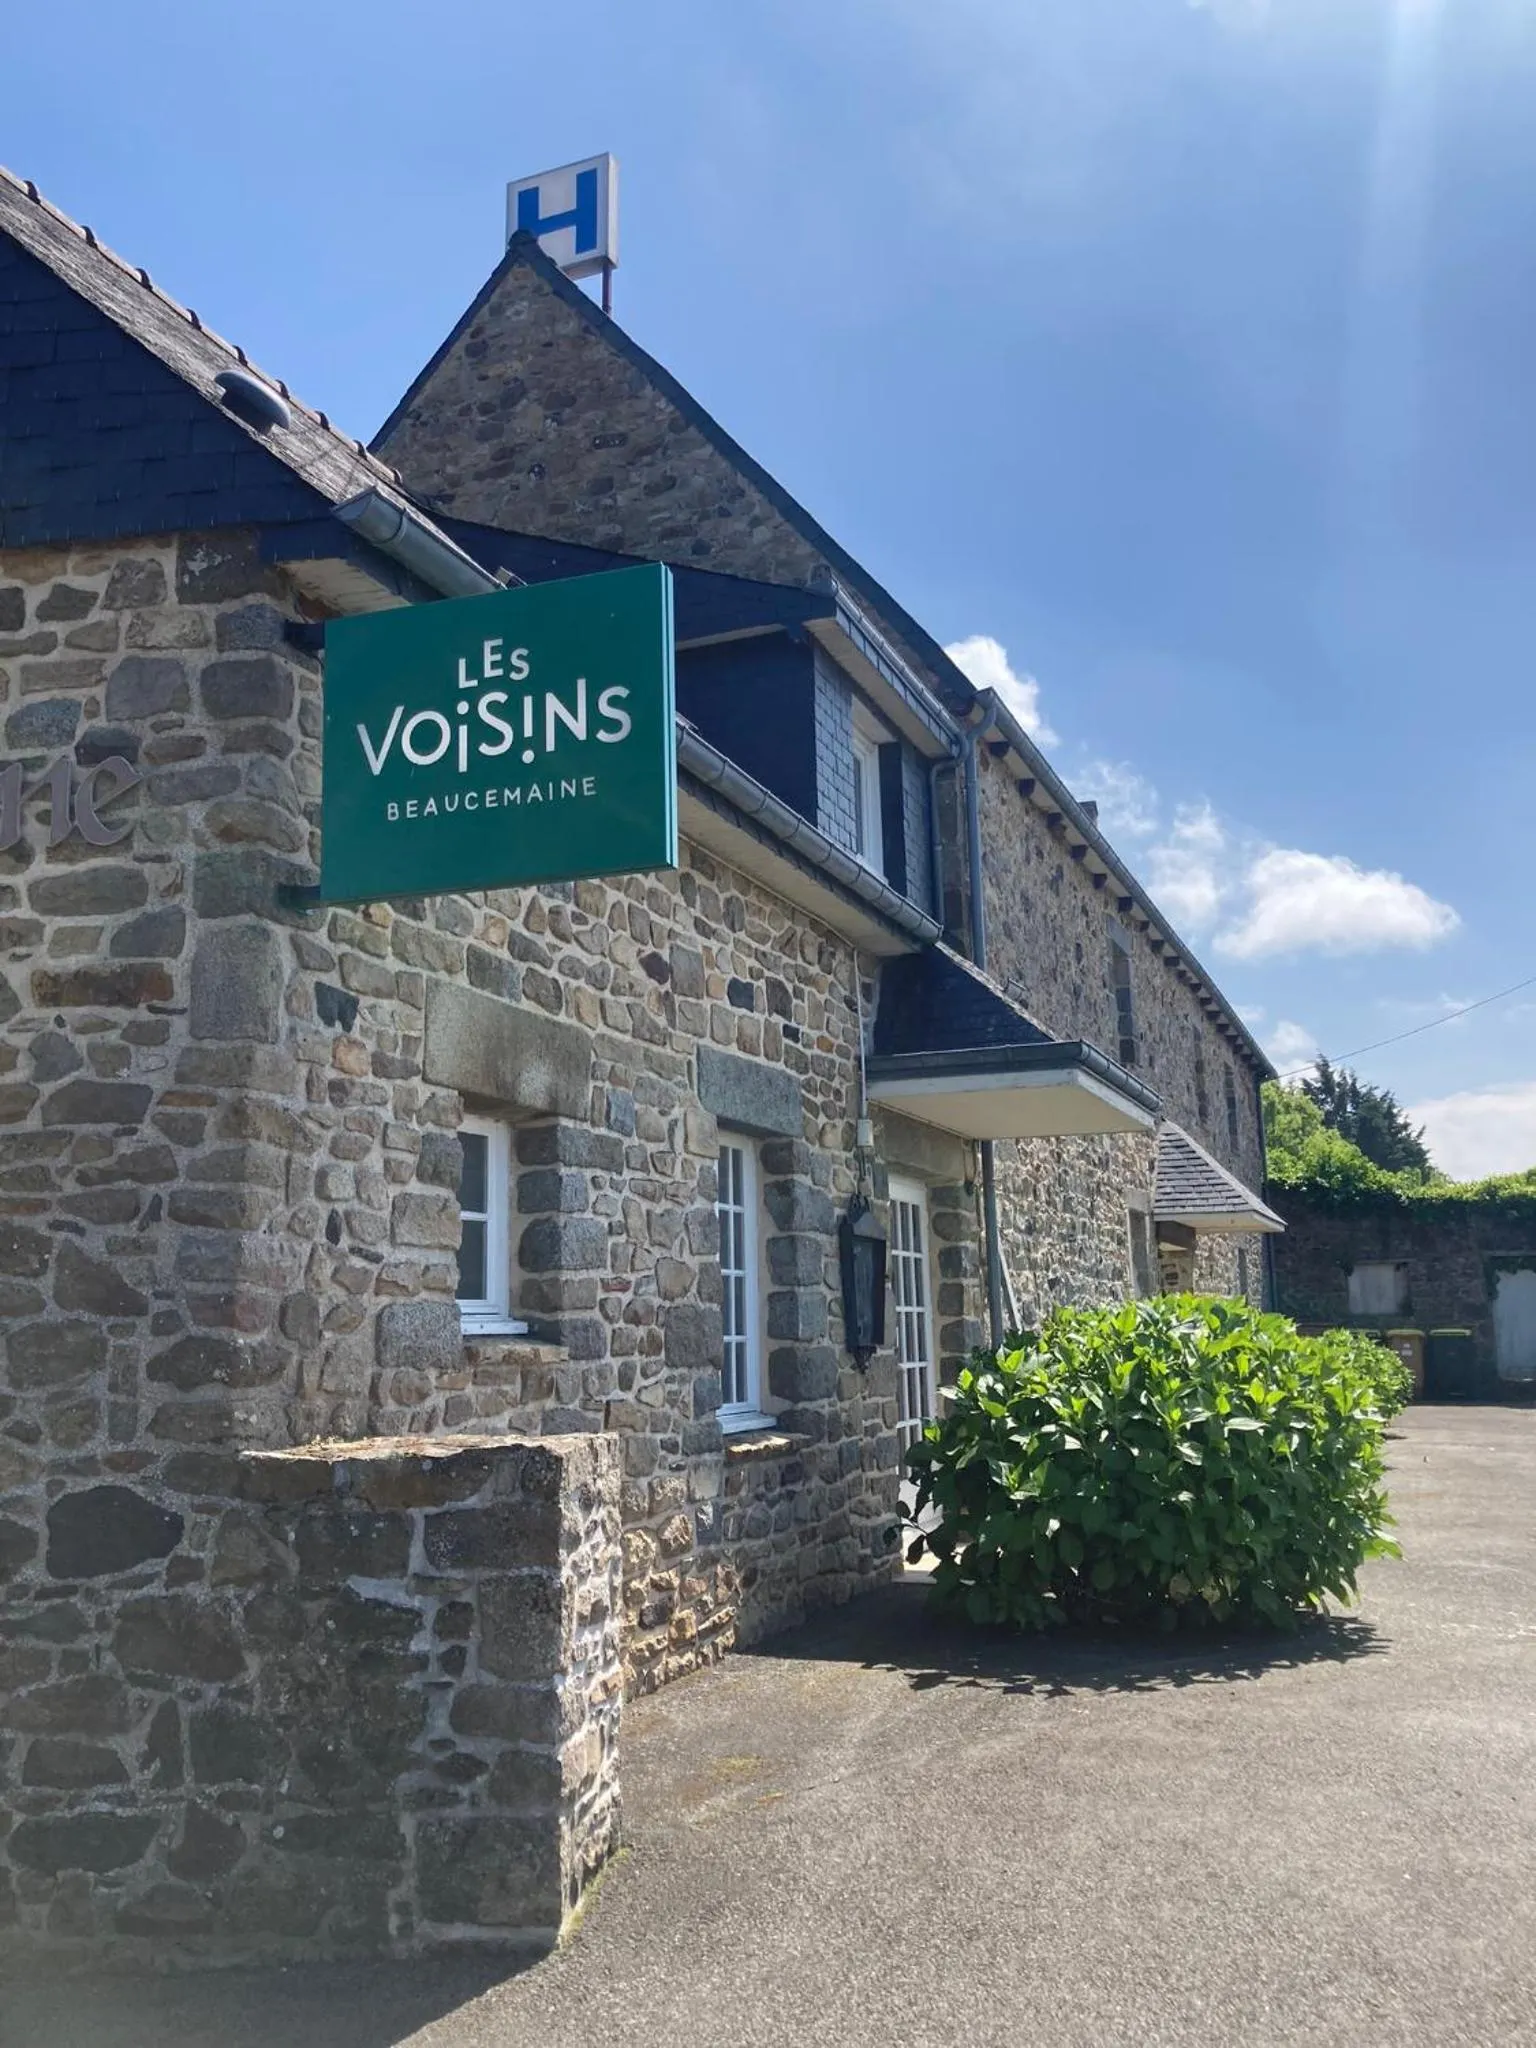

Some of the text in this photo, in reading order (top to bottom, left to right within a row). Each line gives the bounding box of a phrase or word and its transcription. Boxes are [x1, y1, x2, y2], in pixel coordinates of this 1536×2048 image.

[518, 168, 598, 254] H
[458, 639, 531, 689] LES
[387, 776, 597, 821] BEAUCEMAINE
